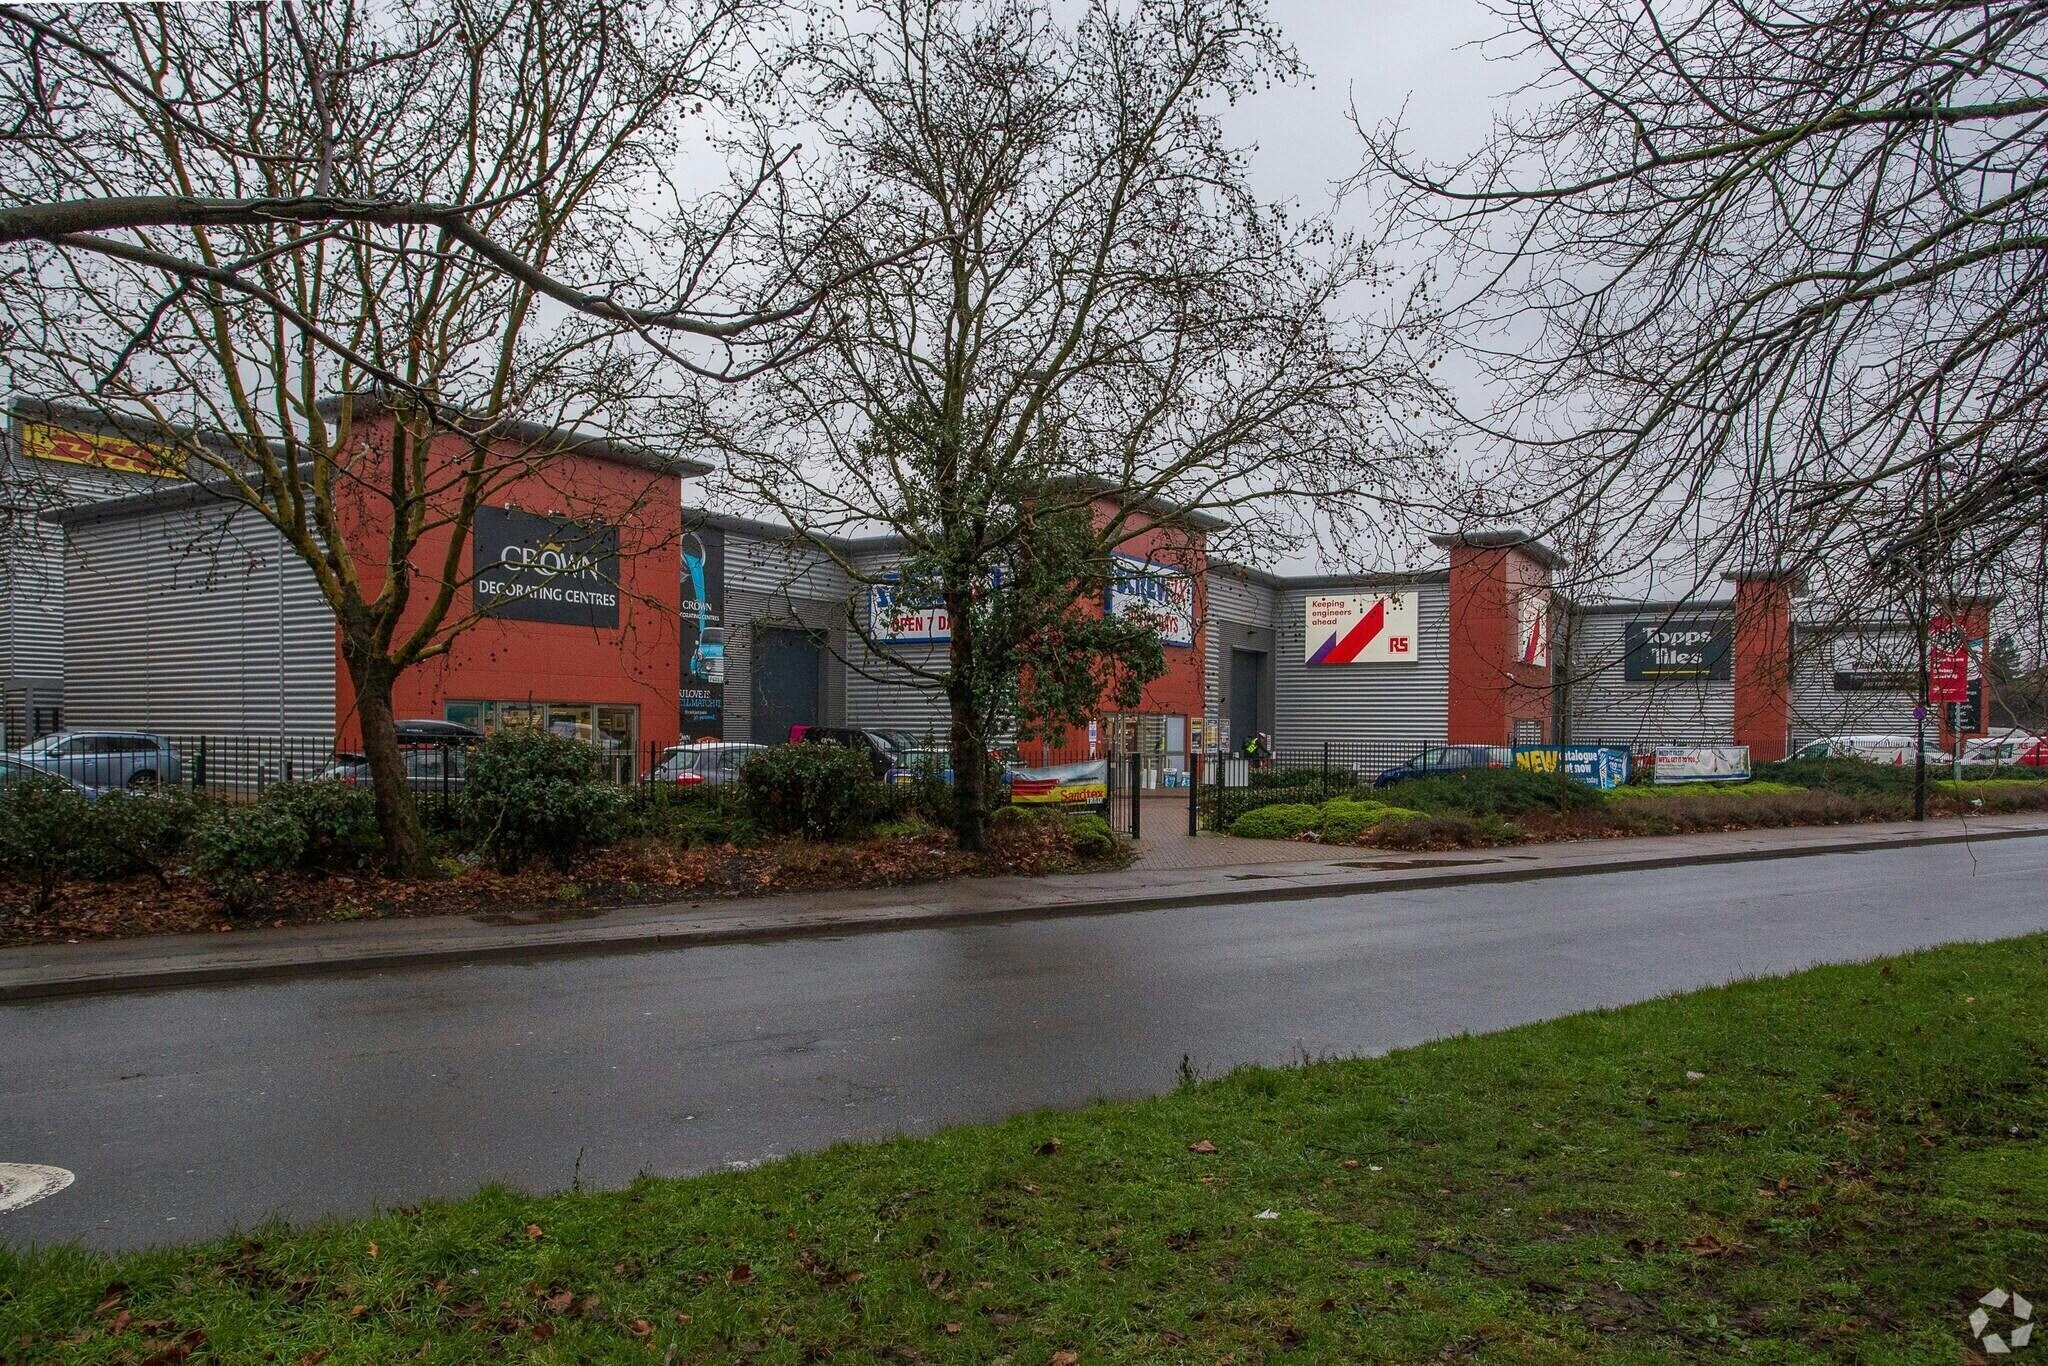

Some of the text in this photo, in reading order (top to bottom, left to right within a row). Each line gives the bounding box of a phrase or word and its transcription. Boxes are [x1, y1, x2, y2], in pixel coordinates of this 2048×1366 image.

[501, 545, 599, 581] CROWN
[479, 580, 616, 607] DECORATING CENTRES
[1312, 600, 1345, 609] Keeping
[1312, 609, 1352, 618] engineers
[1312, 618, 1338, 626] ahead
[1642, 627, 1712, 646] Topps
[1389, 637, 1408, 653] RS
[1651, 647, 1703, 664] Tiles
[1515, 751, 1558, 774] NEW
[1574, 763, 1592, 773] now
[1060, 789, 1105, 801] Sandtex
